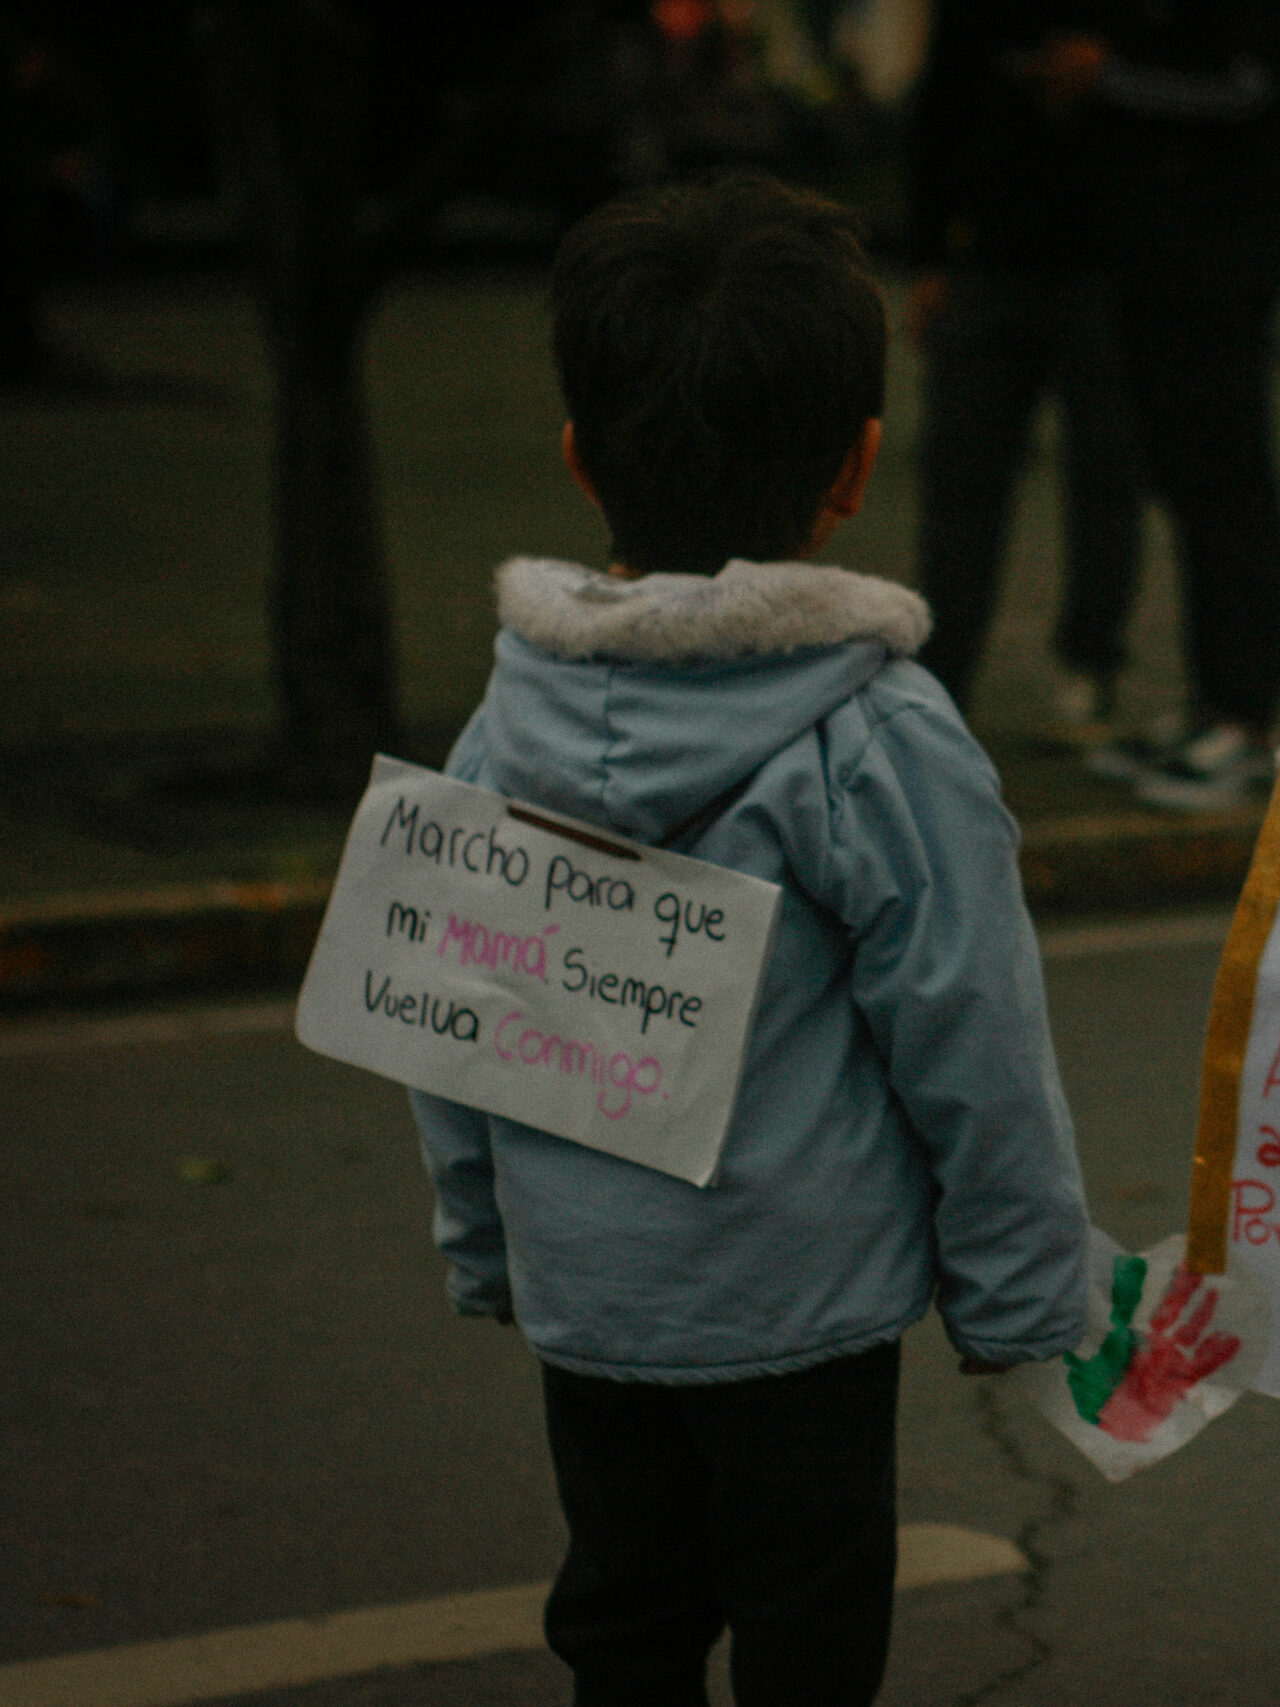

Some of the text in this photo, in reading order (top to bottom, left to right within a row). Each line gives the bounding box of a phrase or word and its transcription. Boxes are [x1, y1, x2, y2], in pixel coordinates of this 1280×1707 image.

[381, 797, 726, 957] Marcho para que
[387, 901, 431, 942] mi
[562, 948, 702, 1034] Siempre
